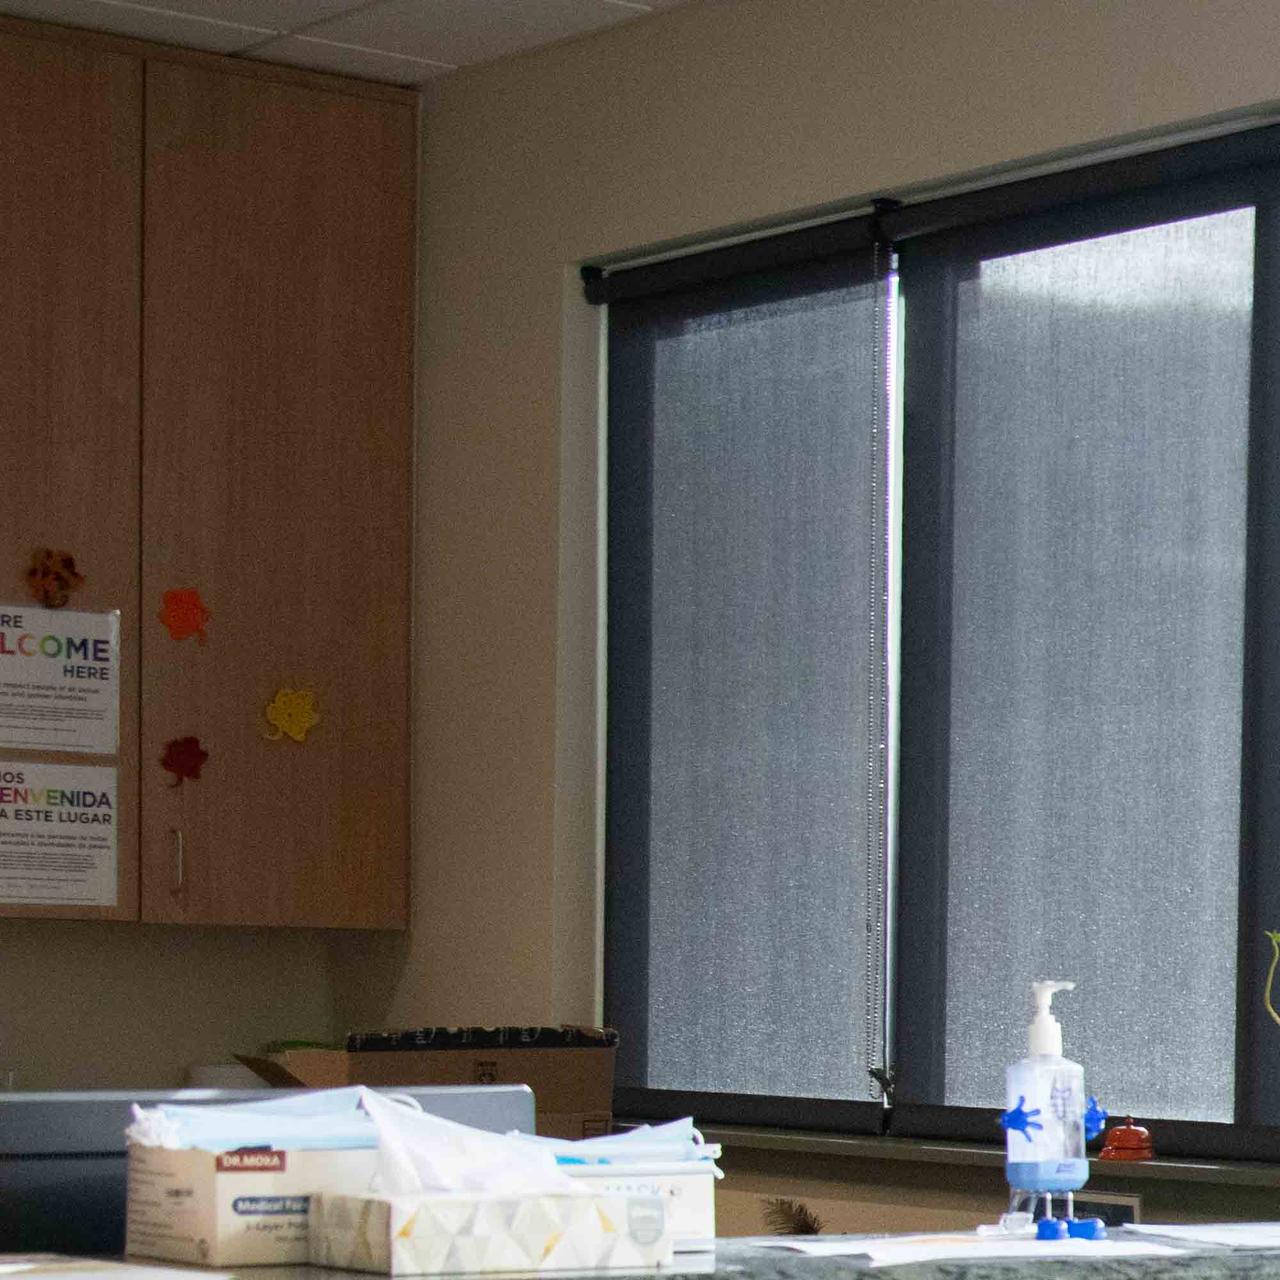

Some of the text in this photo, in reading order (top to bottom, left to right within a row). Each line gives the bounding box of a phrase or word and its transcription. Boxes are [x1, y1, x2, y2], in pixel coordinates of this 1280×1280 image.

[63, 665, 110, 680] HERE
[15, 809, 54, 822] ESTE
[59, 812, 112, 825] LUGAR
